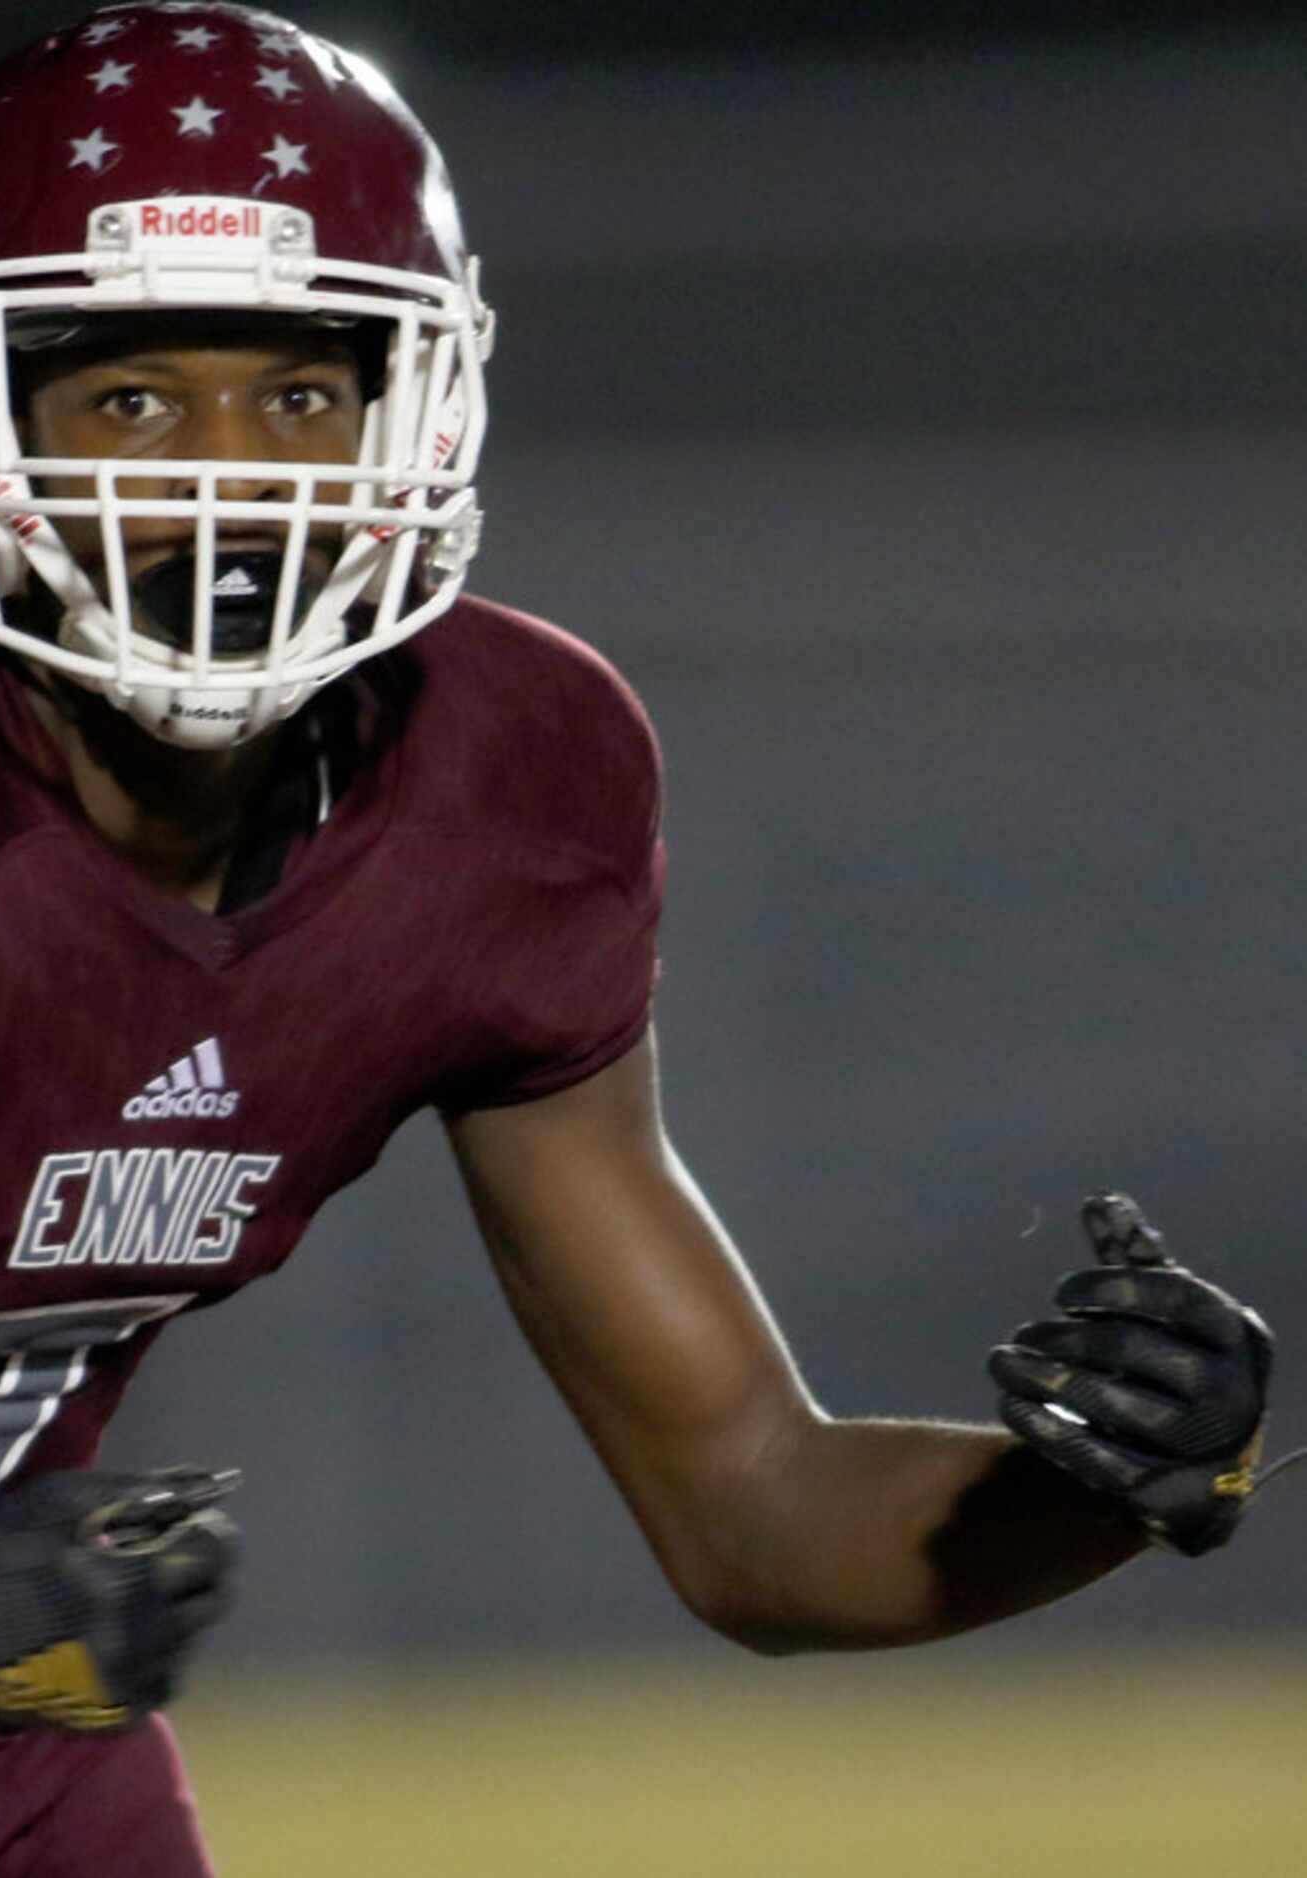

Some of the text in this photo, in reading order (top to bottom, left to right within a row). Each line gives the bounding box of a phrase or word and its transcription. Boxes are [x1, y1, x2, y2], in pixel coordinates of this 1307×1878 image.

[140, 204, 262, 238] Riddell
[121, 1086, 240, 1120] adidas
[7, 1148, 282, 1269] ENNIS
